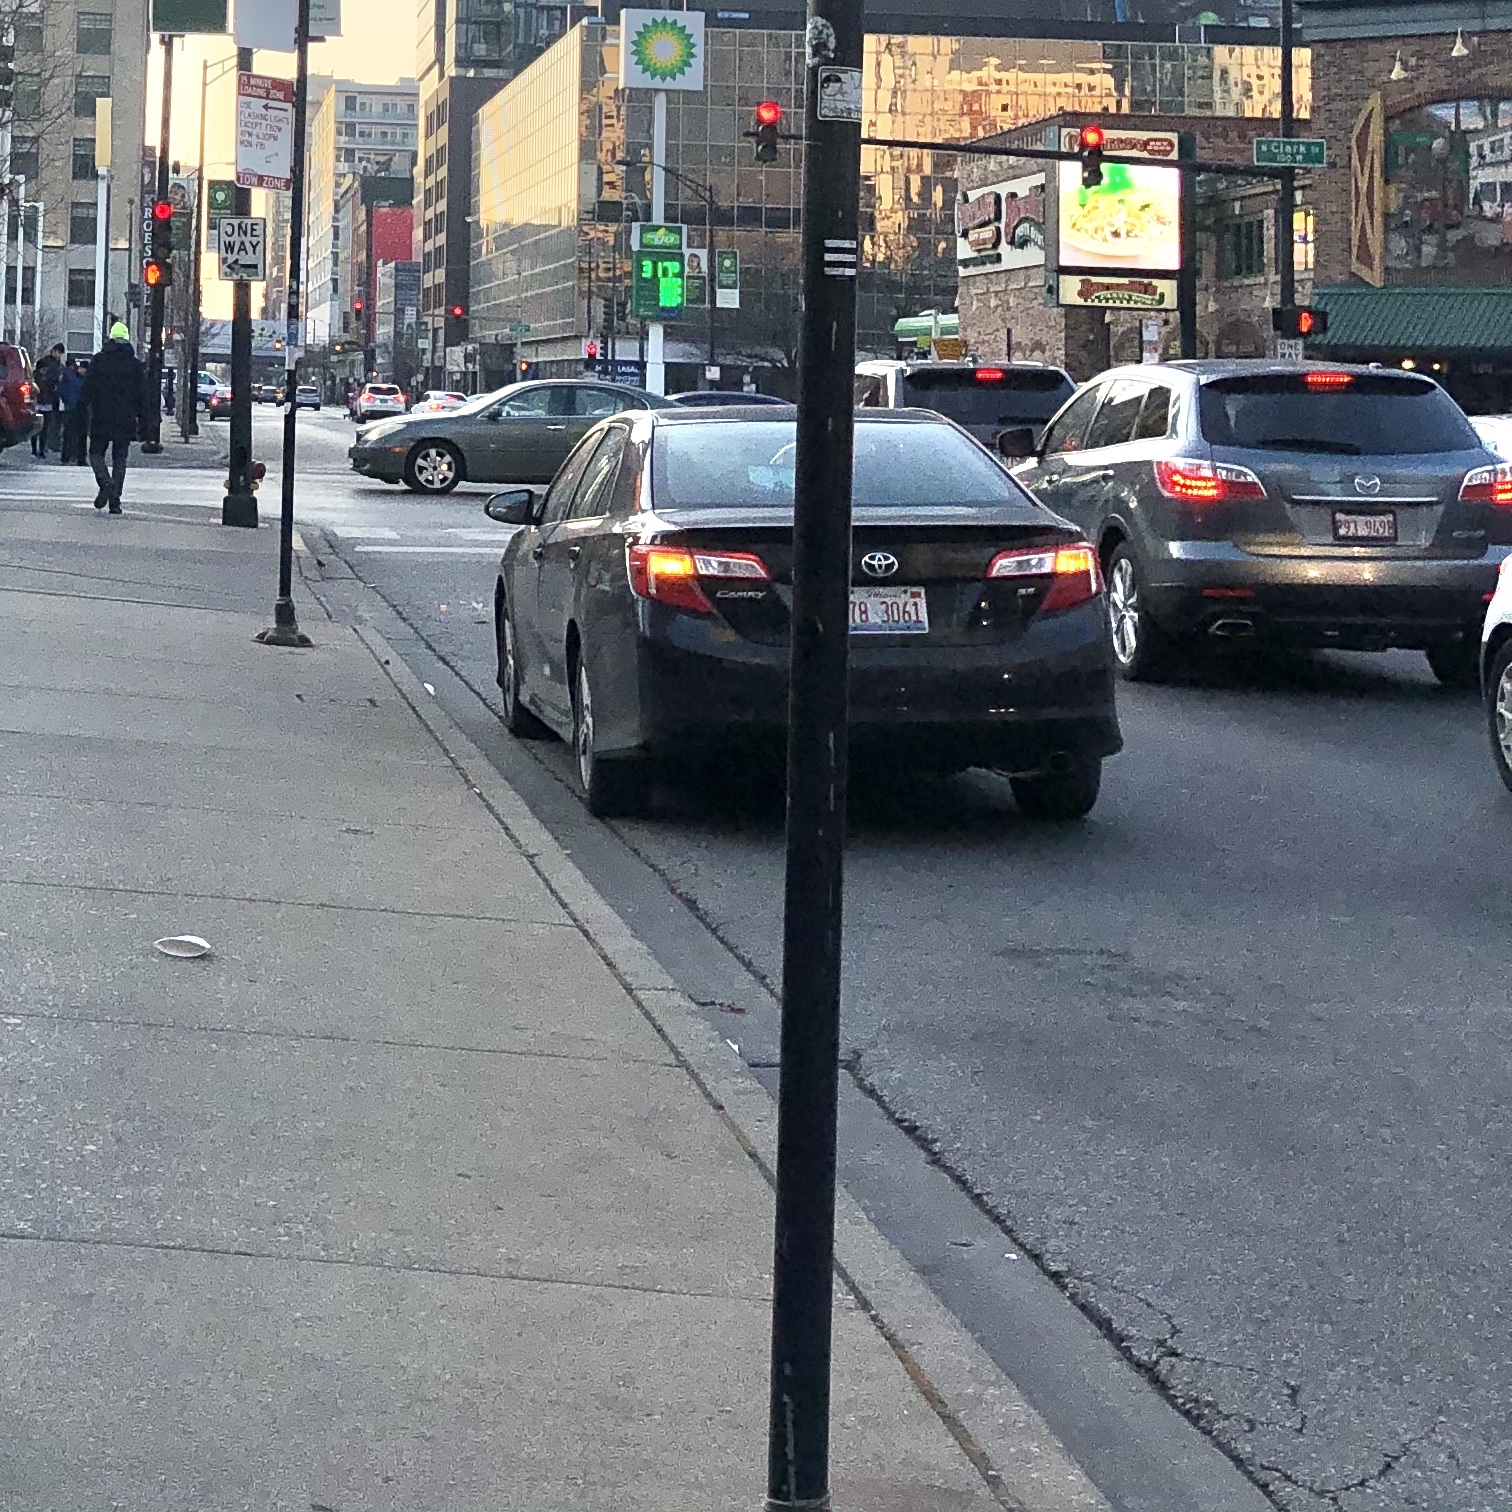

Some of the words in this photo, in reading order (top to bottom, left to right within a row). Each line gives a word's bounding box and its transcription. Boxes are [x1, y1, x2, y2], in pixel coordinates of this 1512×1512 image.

[250, 77, 272, 88] MINUTE
[240, 86, 267, 97] LOADING
[240, 111, 269, 122] FLASHING
[269, 114, 290, 125] LIGHTS
[240, 121, 262, 129] EXCEPT
[1271, 141, 1306, 154] Clark
[238, 173, 258, 186] TOW
[262, 176, 287, 190] ZONE
[224, 222, 260, 238] ONE
[223, 240, 261, 256] WAY
[1279, 341, 1301, 351] ONE
[715, 590, 767, 599] CAMRY
[879, 601, 924, 624] 3061
